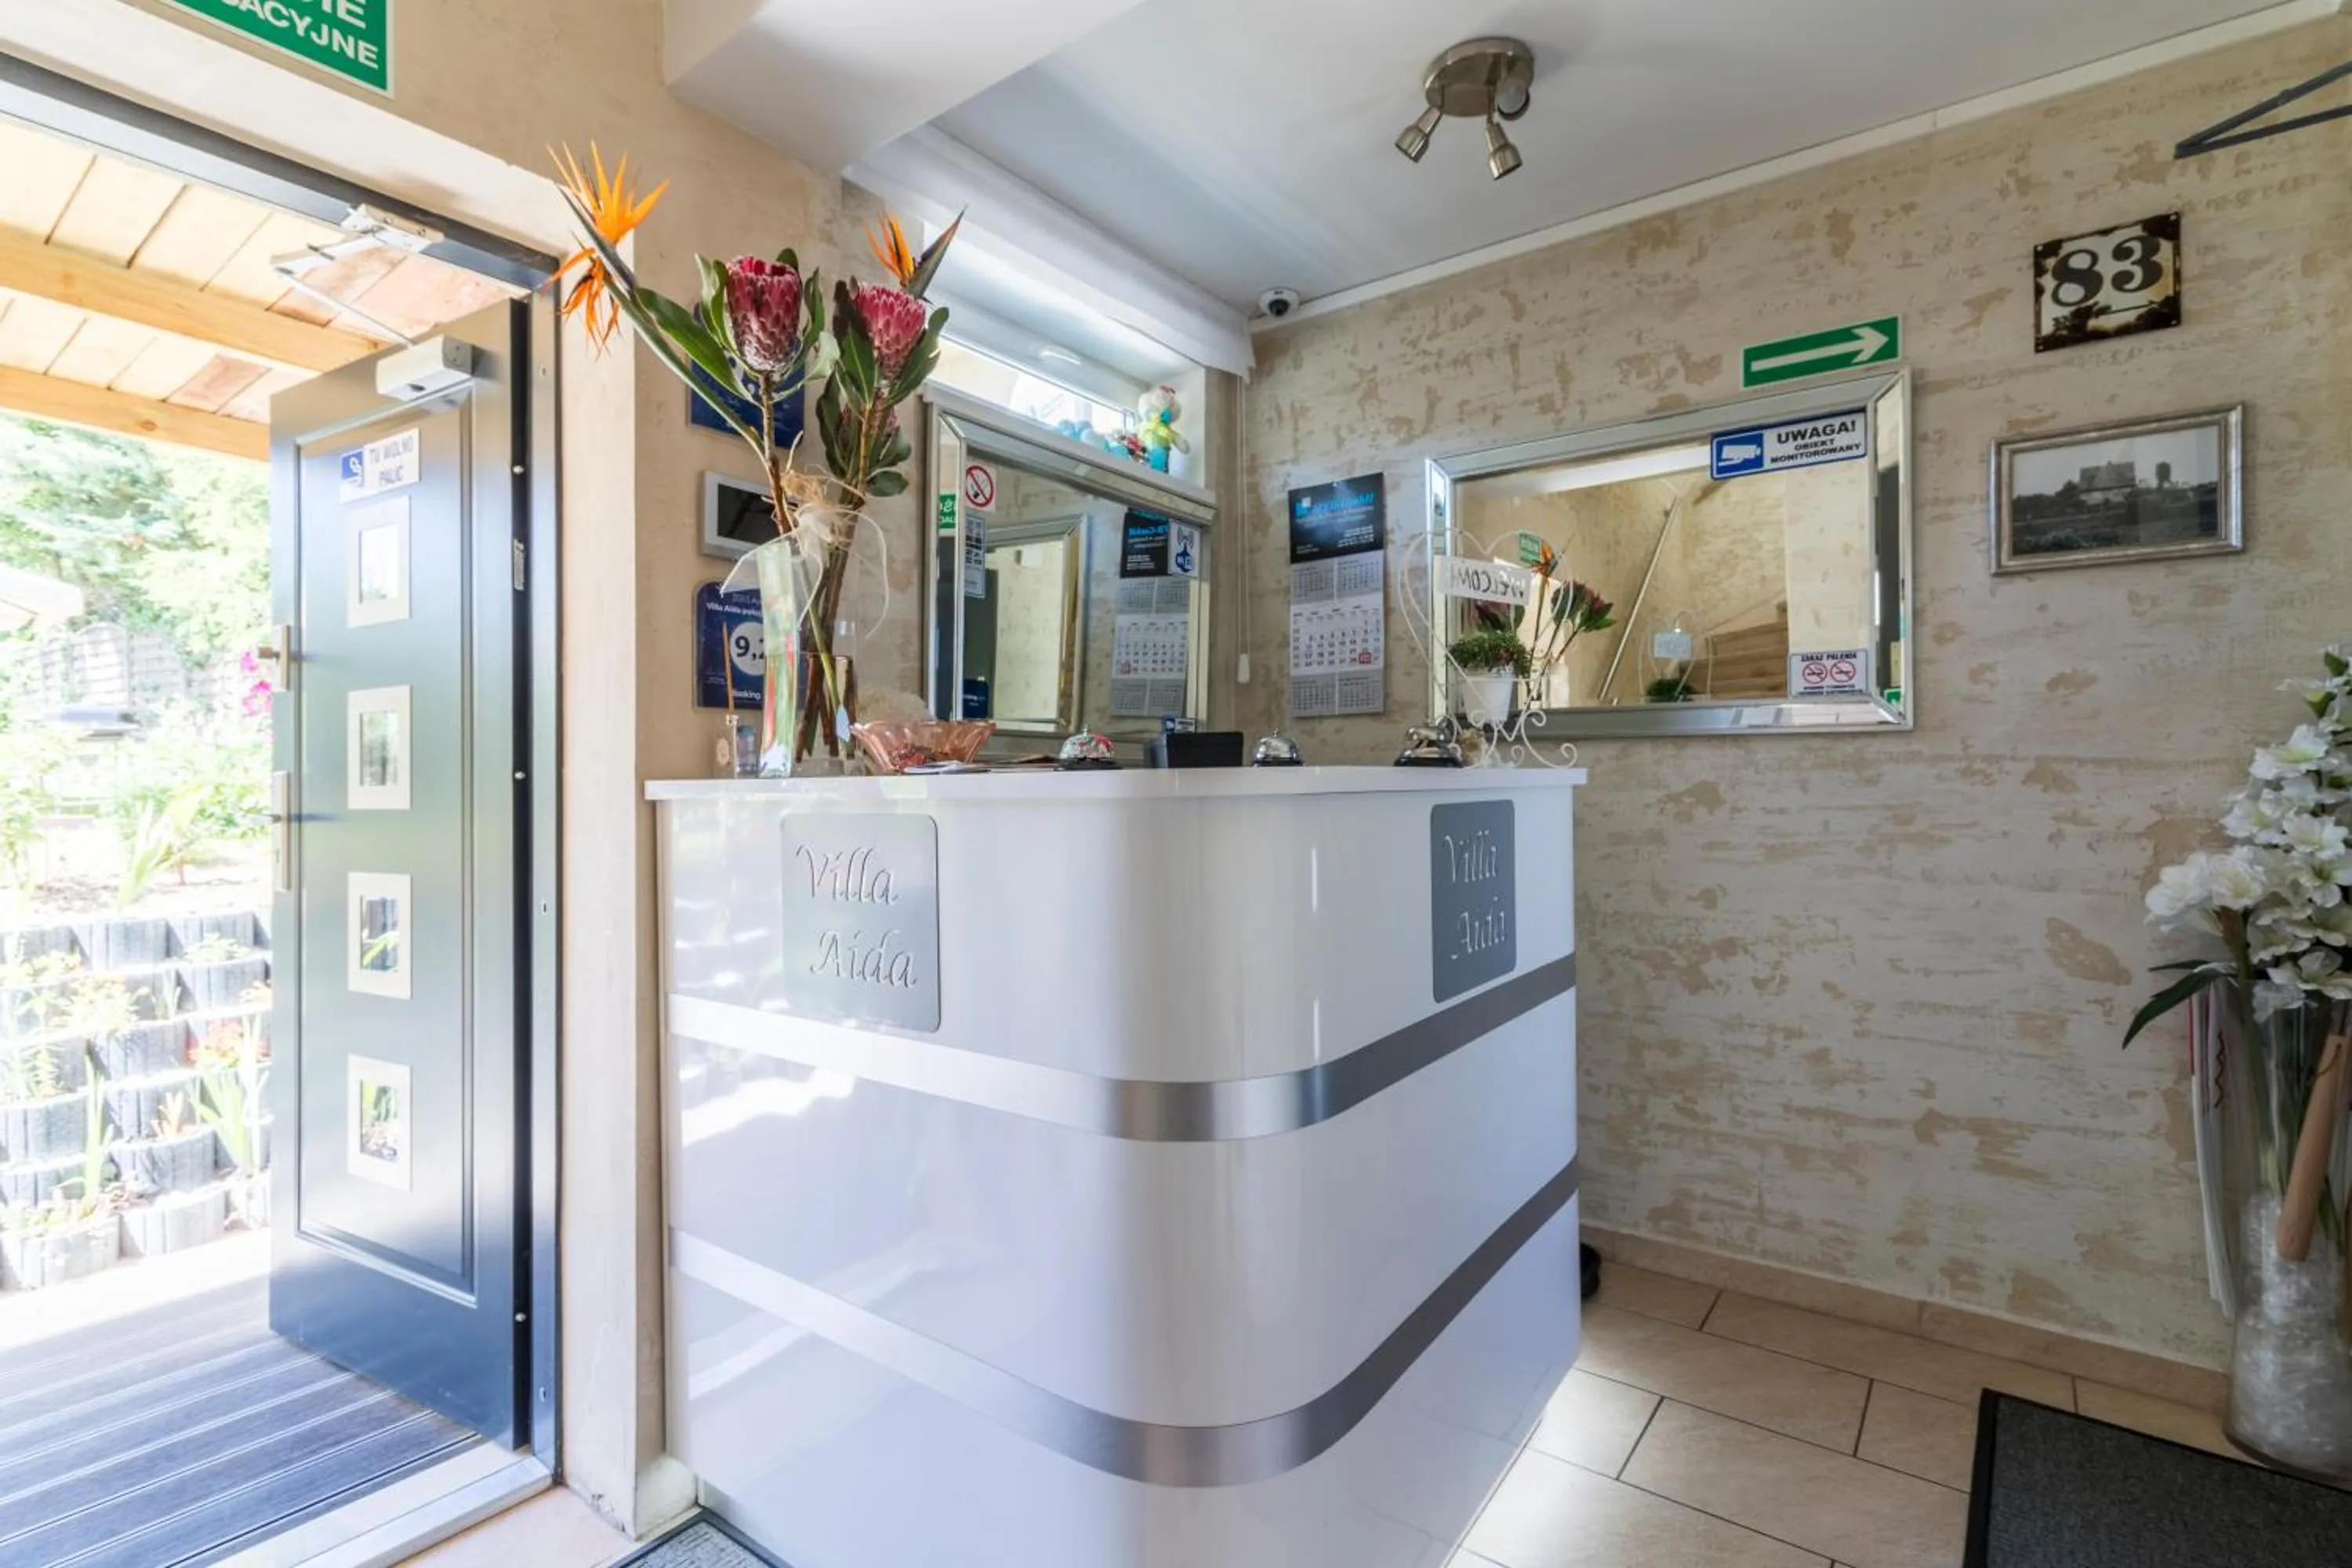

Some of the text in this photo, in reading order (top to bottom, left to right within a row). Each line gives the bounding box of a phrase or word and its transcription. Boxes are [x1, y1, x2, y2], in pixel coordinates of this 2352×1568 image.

[222, 0, 379, 71] ACYJNE
[2051, 234, 2164, 307] 83
[1769, 443, 1862, 464] MONITOROWANY
[1777, 419, 1857, 445] UWAGA!
[1794, 438, 1835, 452] OBIEKT
[797, 844, 899, 906] Villa
[810, 928, 918, 989] Aida
